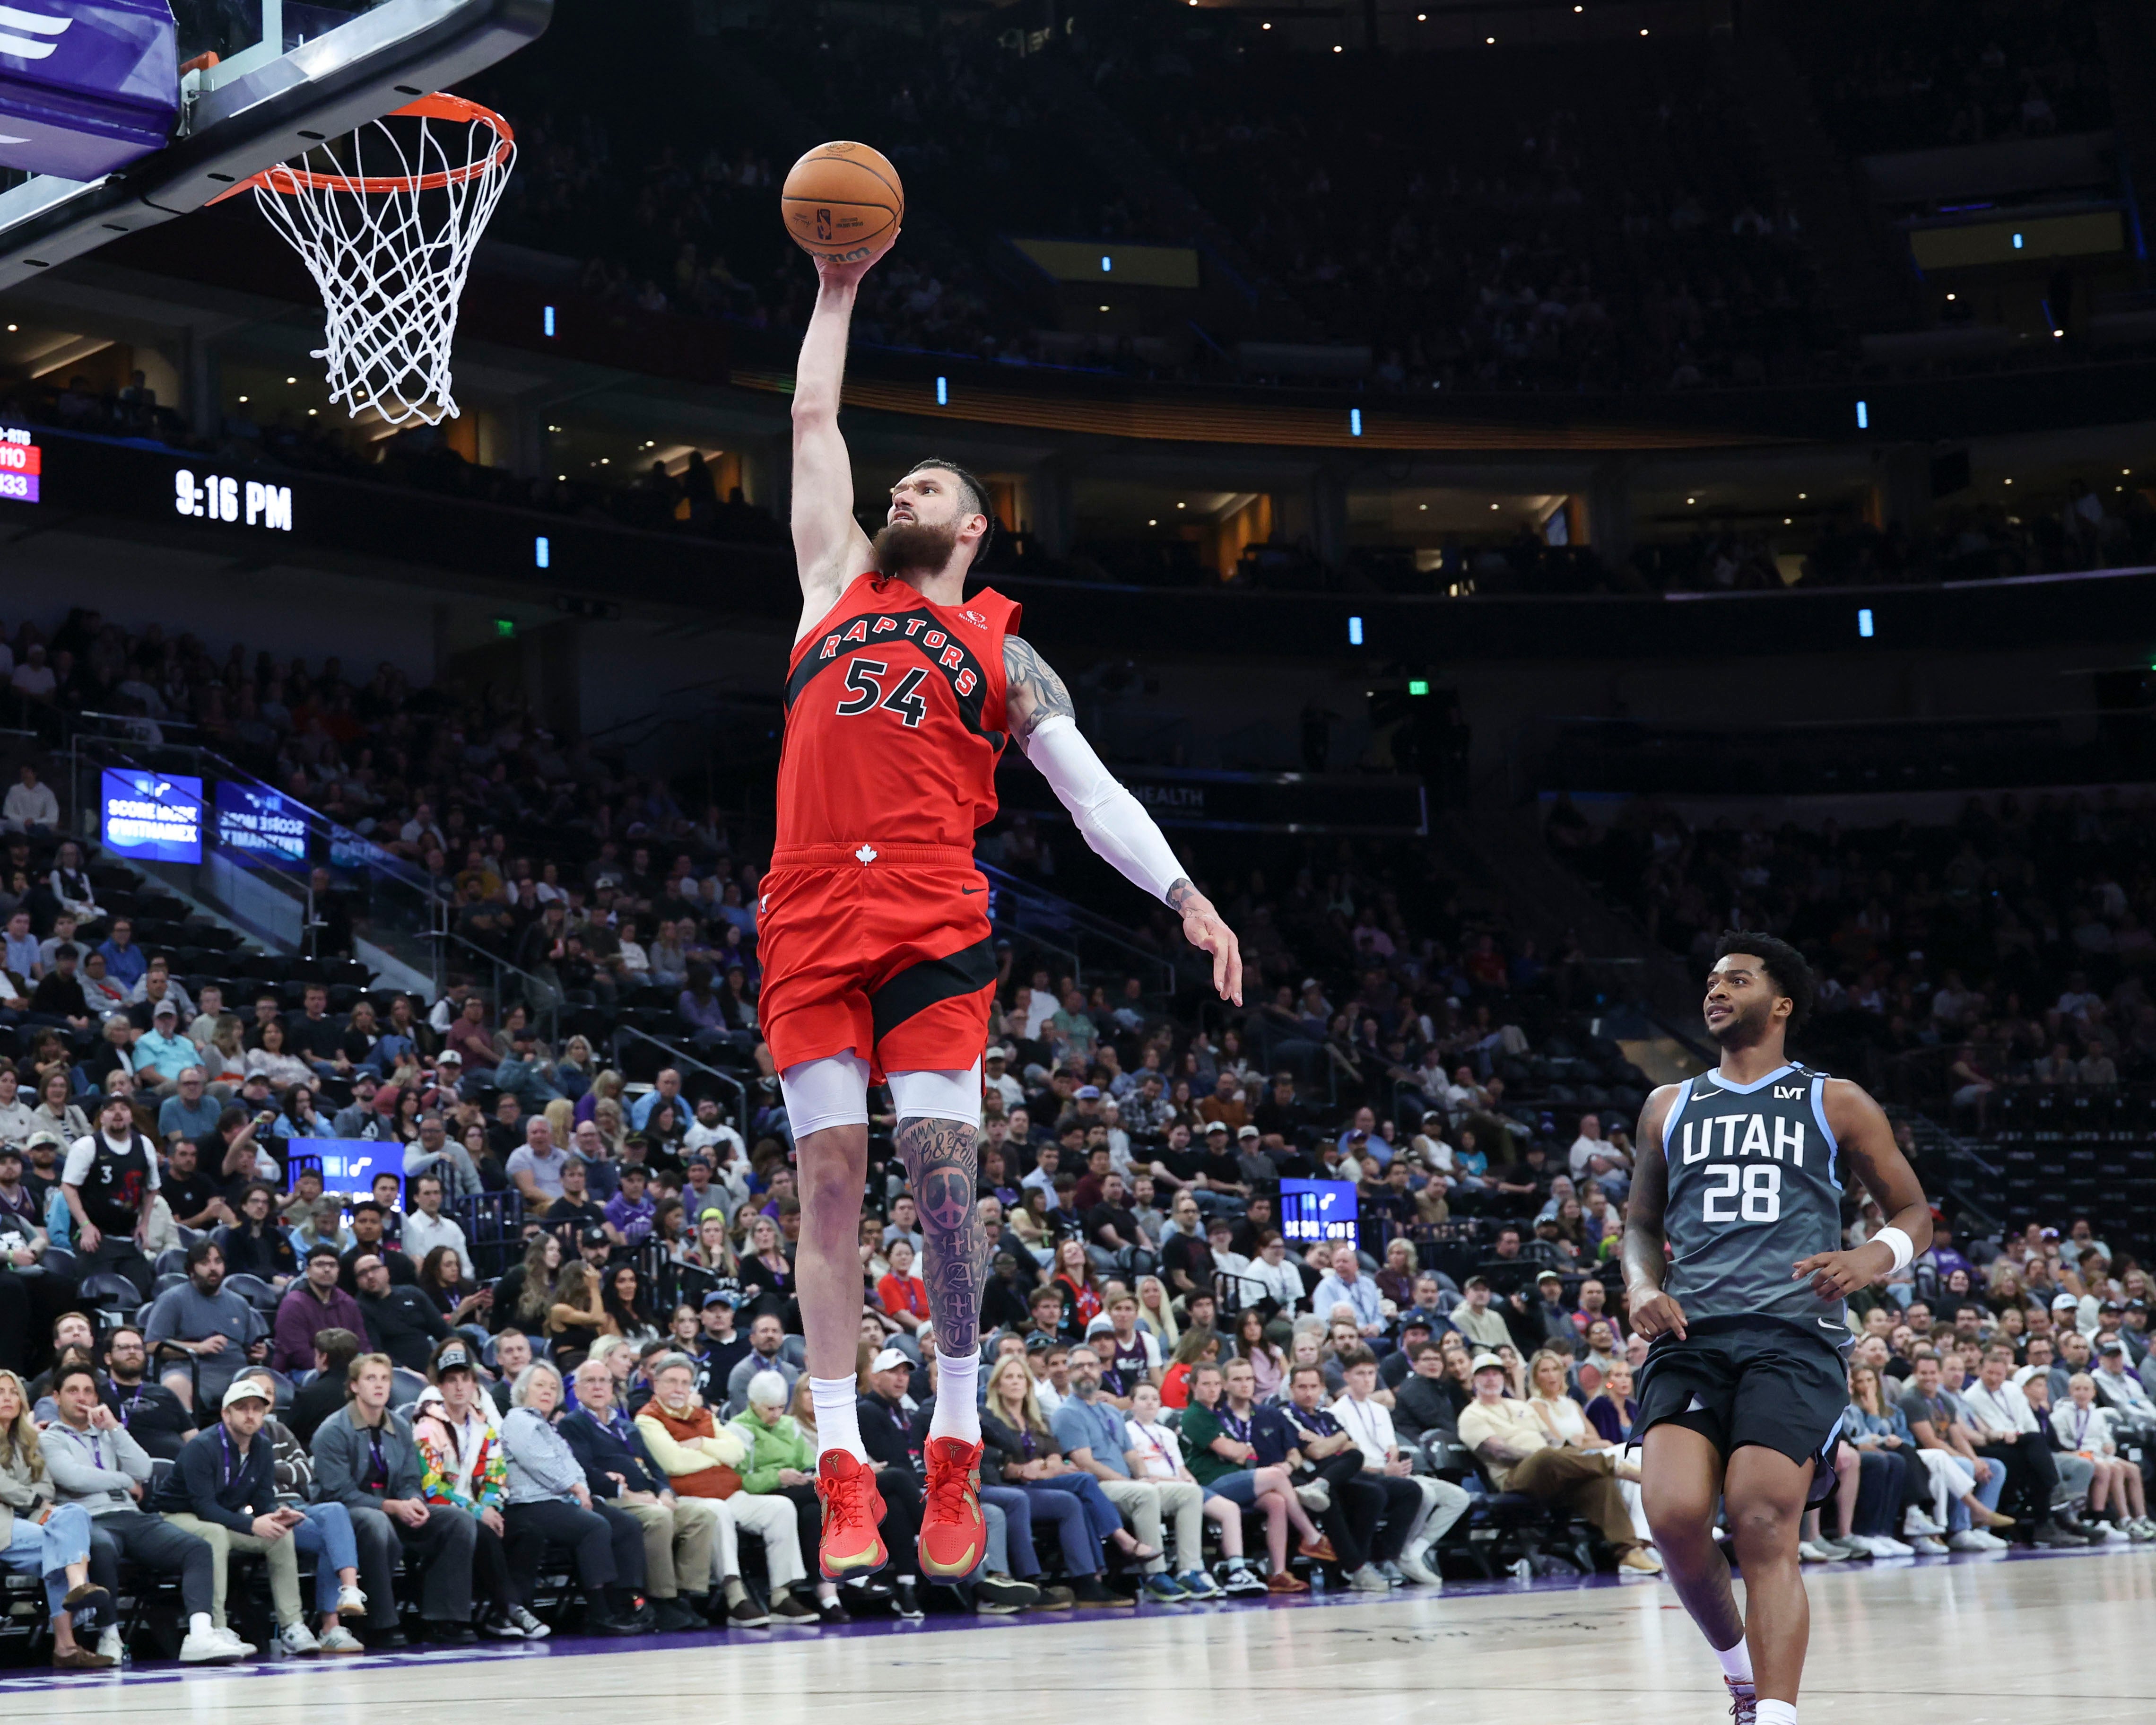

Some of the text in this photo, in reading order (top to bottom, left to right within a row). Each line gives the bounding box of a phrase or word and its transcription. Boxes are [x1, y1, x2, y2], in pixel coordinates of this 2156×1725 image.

[0, 446, 26, 469] 110
[175, 469, 292, 531] 9:16 PM
[958, 613, 988, 630] Sun Life
[819, 617, 978, 697] RAPTORS
[835, 658, 930, 728] 54
[1797, 1069, 1814, 1078] FRANK
[1773, 1086, 1806, 1100] LVT
[1683, 1114, 1805, 1168] UTAH
[100, 1165, 113, 1184] 3
[1703, 1163, 1782, 1222] 28
